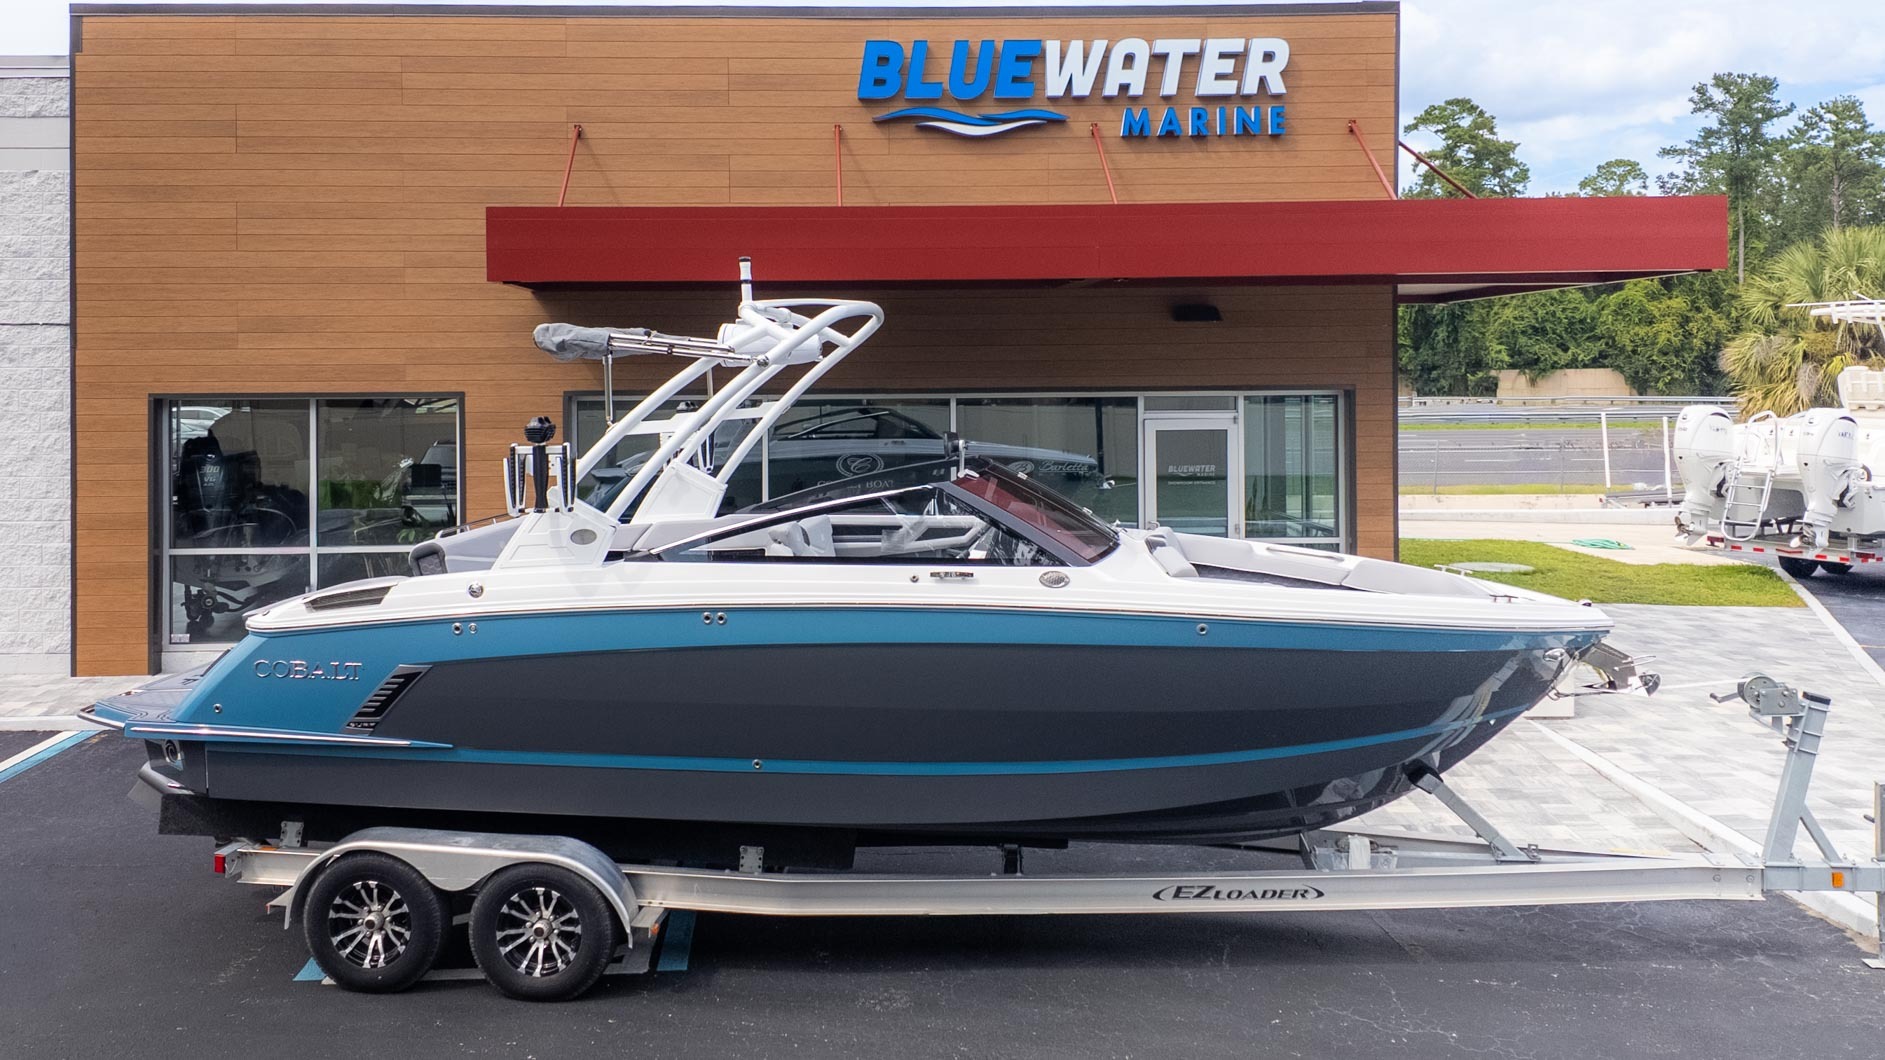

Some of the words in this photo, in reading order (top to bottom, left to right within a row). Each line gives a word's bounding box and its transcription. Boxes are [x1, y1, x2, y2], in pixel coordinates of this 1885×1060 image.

[857, 37, 1290, 100] BLUEWATER
[1120, 106, 1287, 137] MARINE
[1039, 461, 1089, 472] Barletta
[1168, 464, 1216, 472] BLUEWATER
[254, 660, 363, 680] COBALT
